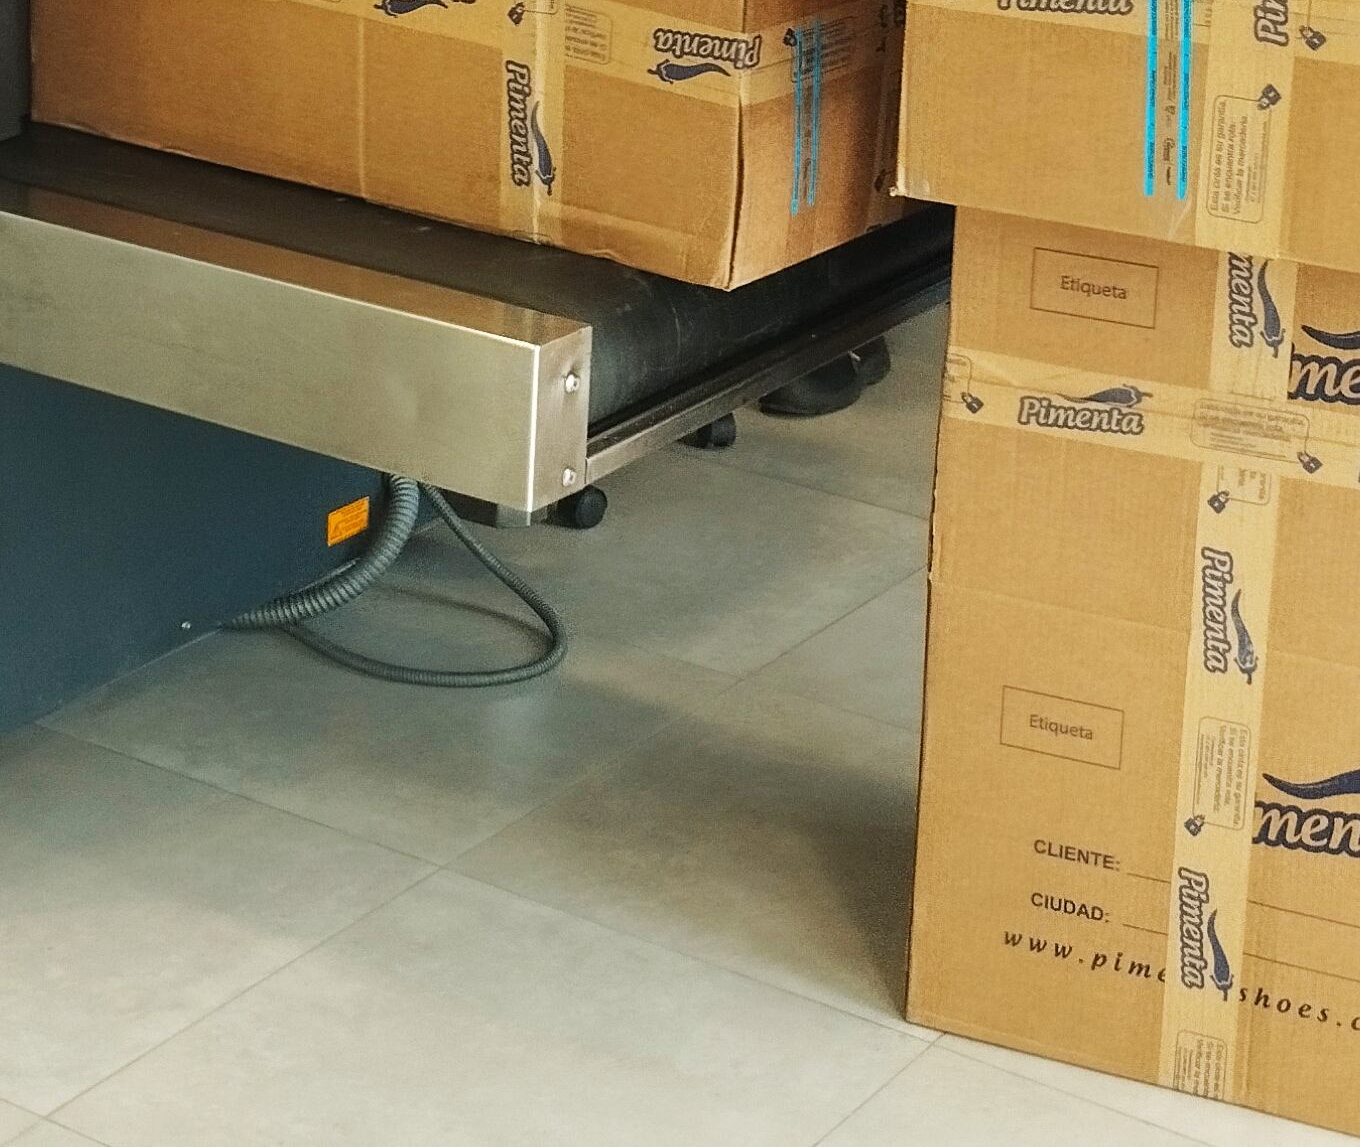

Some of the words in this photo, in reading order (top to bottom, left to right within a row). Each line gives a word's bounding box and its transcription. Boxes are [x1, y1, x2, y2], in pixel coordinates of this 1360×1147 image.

[654, 28, 762, 70] Pimenta
[506, 60, 533, 187] Pimenta
[1060, 274, 1128, 300] Etiqueta
[1227, 251, 1257, 348] menta
[1017, 396, 1145, 436] Pimenta
[1201, 546, 1233, 675] Pimenta
[1028, 713, 1095, 741] Etiqueta
[1033, 837, 1121, 872] CLIENTE:
[1030, 891, 1111, 923] CIUDAD:
[1178, 865, 1208, 990] Pimenta
